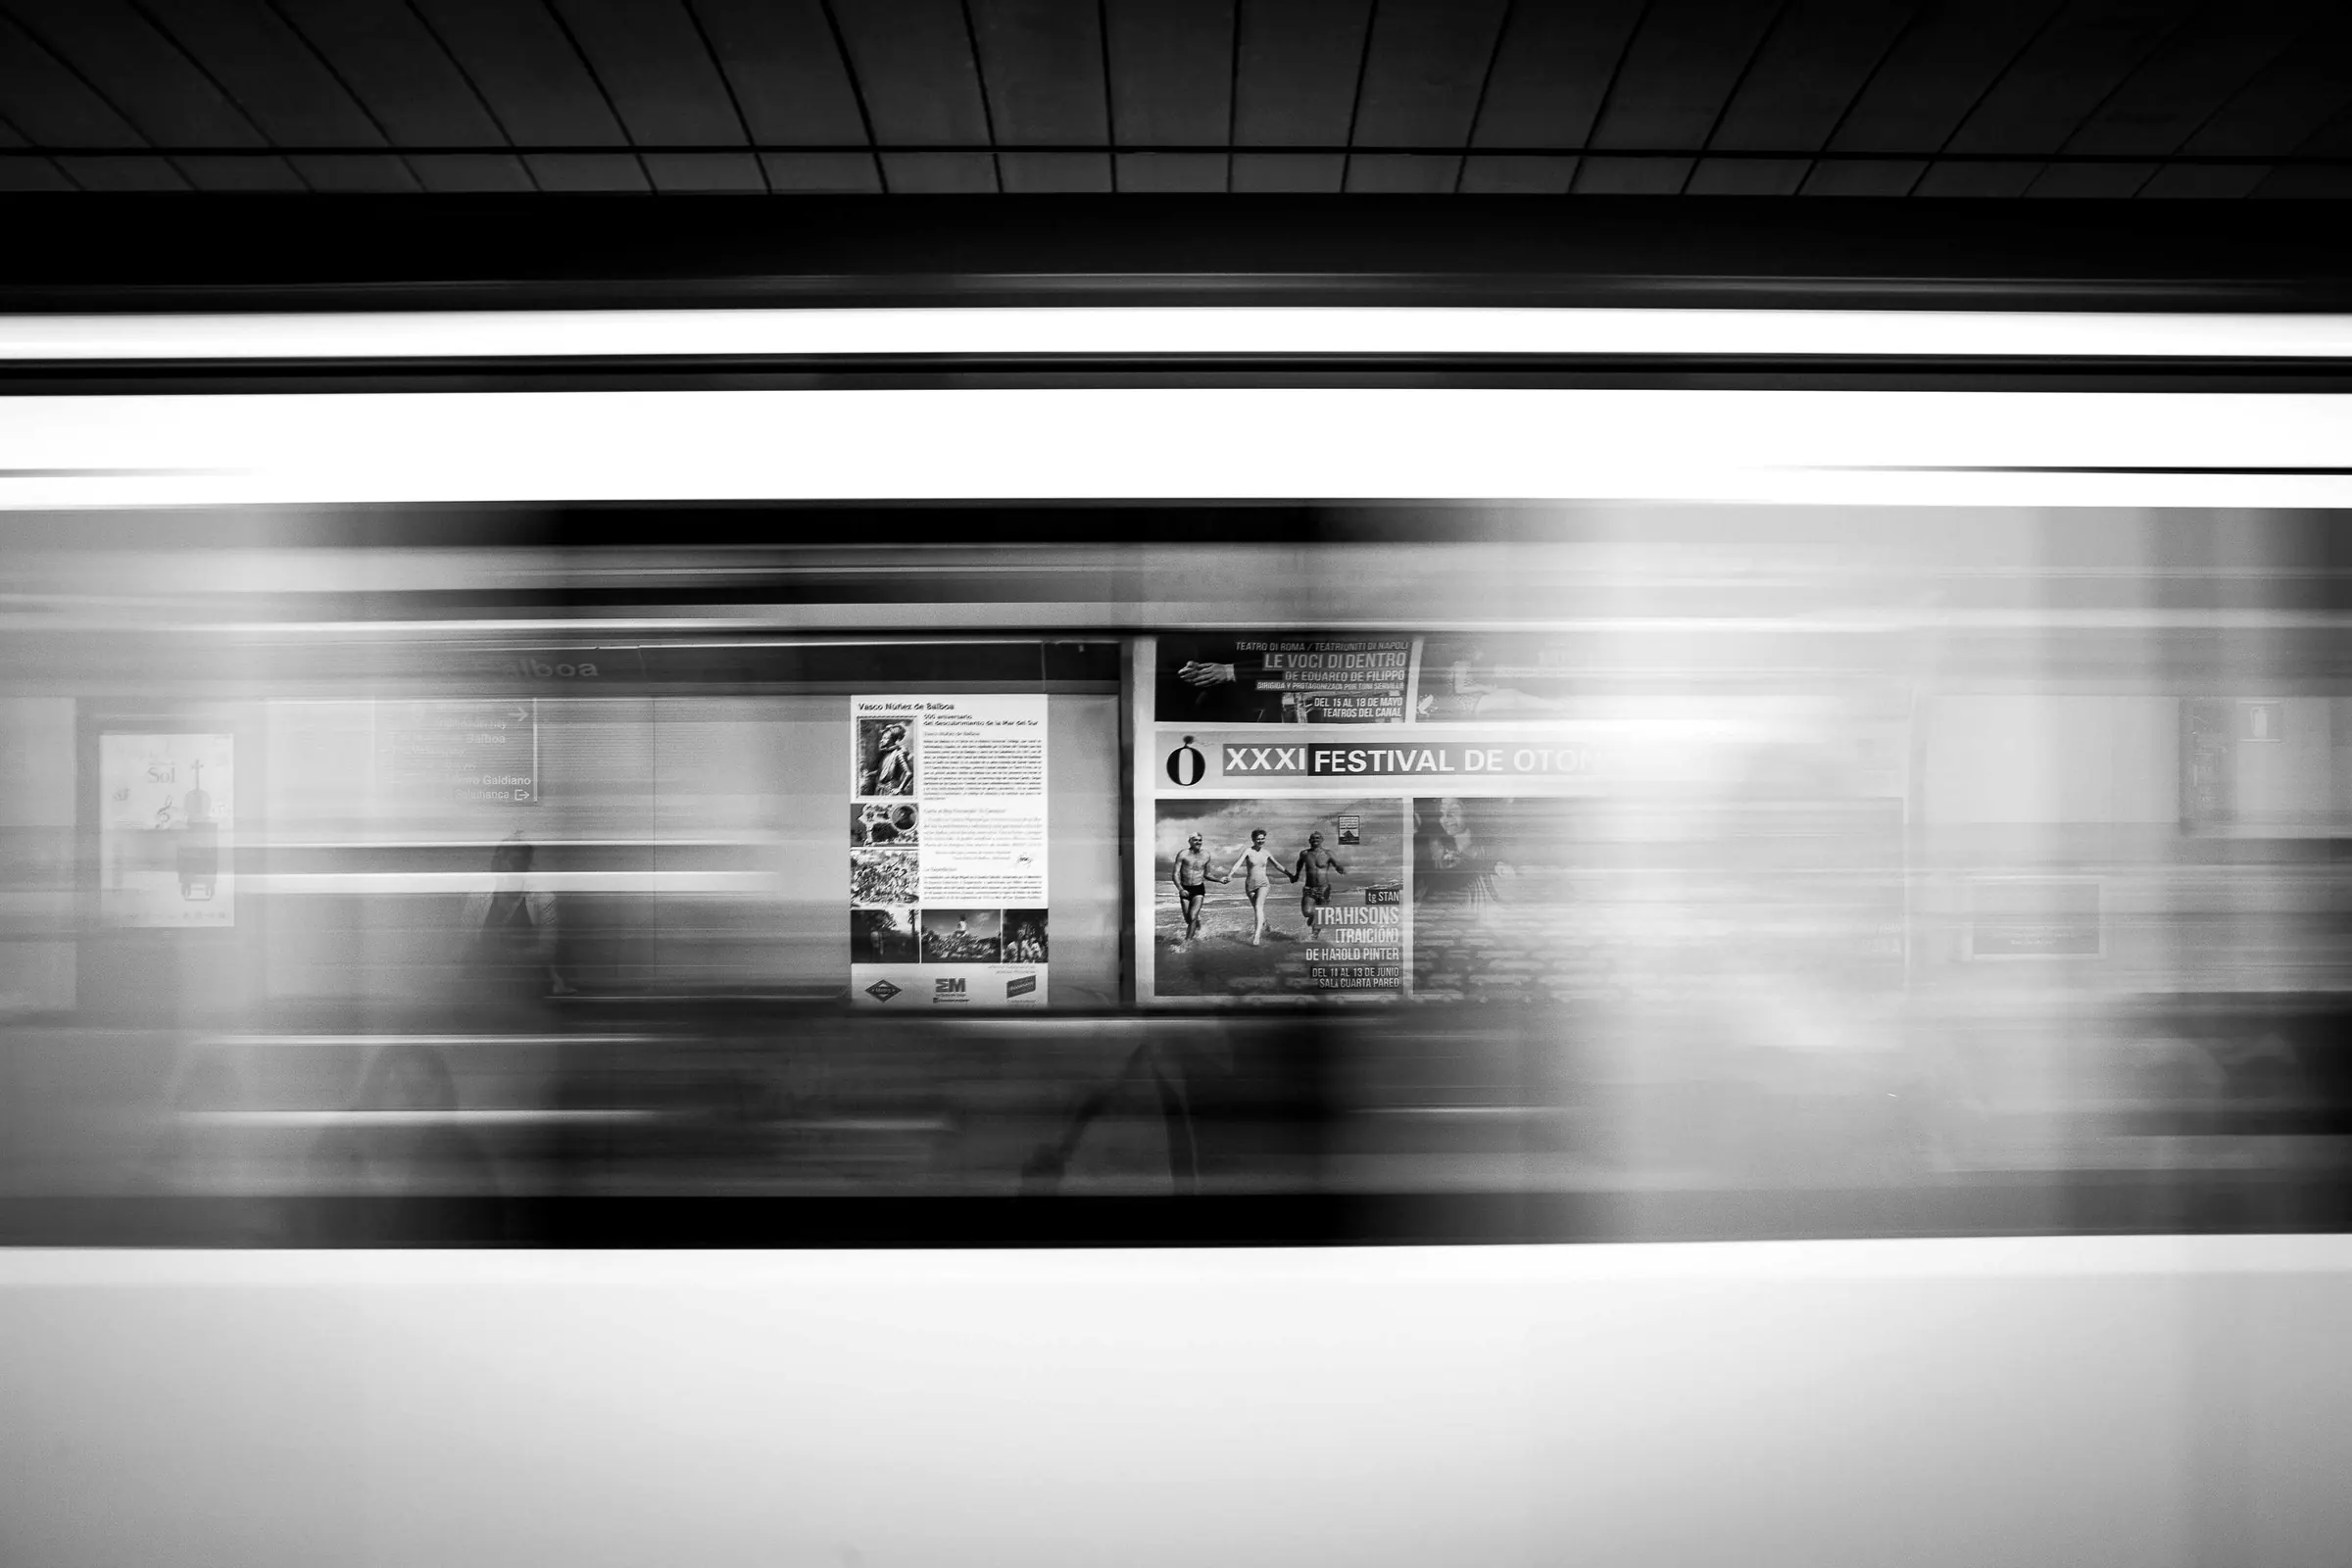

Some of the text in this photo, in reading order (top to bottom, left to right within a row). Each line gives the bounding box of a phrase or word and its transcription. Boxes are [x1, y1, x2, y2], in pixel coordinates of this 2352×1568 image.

[1235, 641, 1267, 651] TEATRO
[1263, 652, 1407, 668] LE VOCI DI DENTRO
[1284, 670, 1298, 681] DE
[1349, 670, 1364, 681] DE
[1366, 669, 1405, 681] FILIPPO
[858, 702, 884, 710] Vasco
[912, 702, 925, 710] de
[926, 702, 956, 710] Balboa
[1313, 697, 1331, 708] DEL
[1343, 698, 1353, 708] AL
[1355, 698, 1366, 708] 18
[1367, 698, 1380, 708] DE
[1380, 697, 1403, 707] MAYO
[1322, 708, 1403, 718] TEATROS DEL CANAL
[1225, 747, 1306, 771] XXXI
[1313, 749, 1456, 773] FESTIVAL
[1464, 749, 1504, 772] DE
[146, 765, 176, 784] Sol
[482, 774, 532, 786] Galdiano
[1367, 891, 1399, 904] tg STAN
[1314, 906, 1399, 925] TRAHISONS
[1305, 947, 1399, 961] DE HAROLD PINTER
[1311, 967, 1328, 978] DEL
[1340, 967, 1350, 978] AL
[1352, 967, 1363, 978] 13
[1364, 967, 1376, 978] DE
[1376, 966, 1399, 977] JUNIO
[1340, 978, 1372, 988] CUARTA
[1373, 977, 1399, 988] PARED
